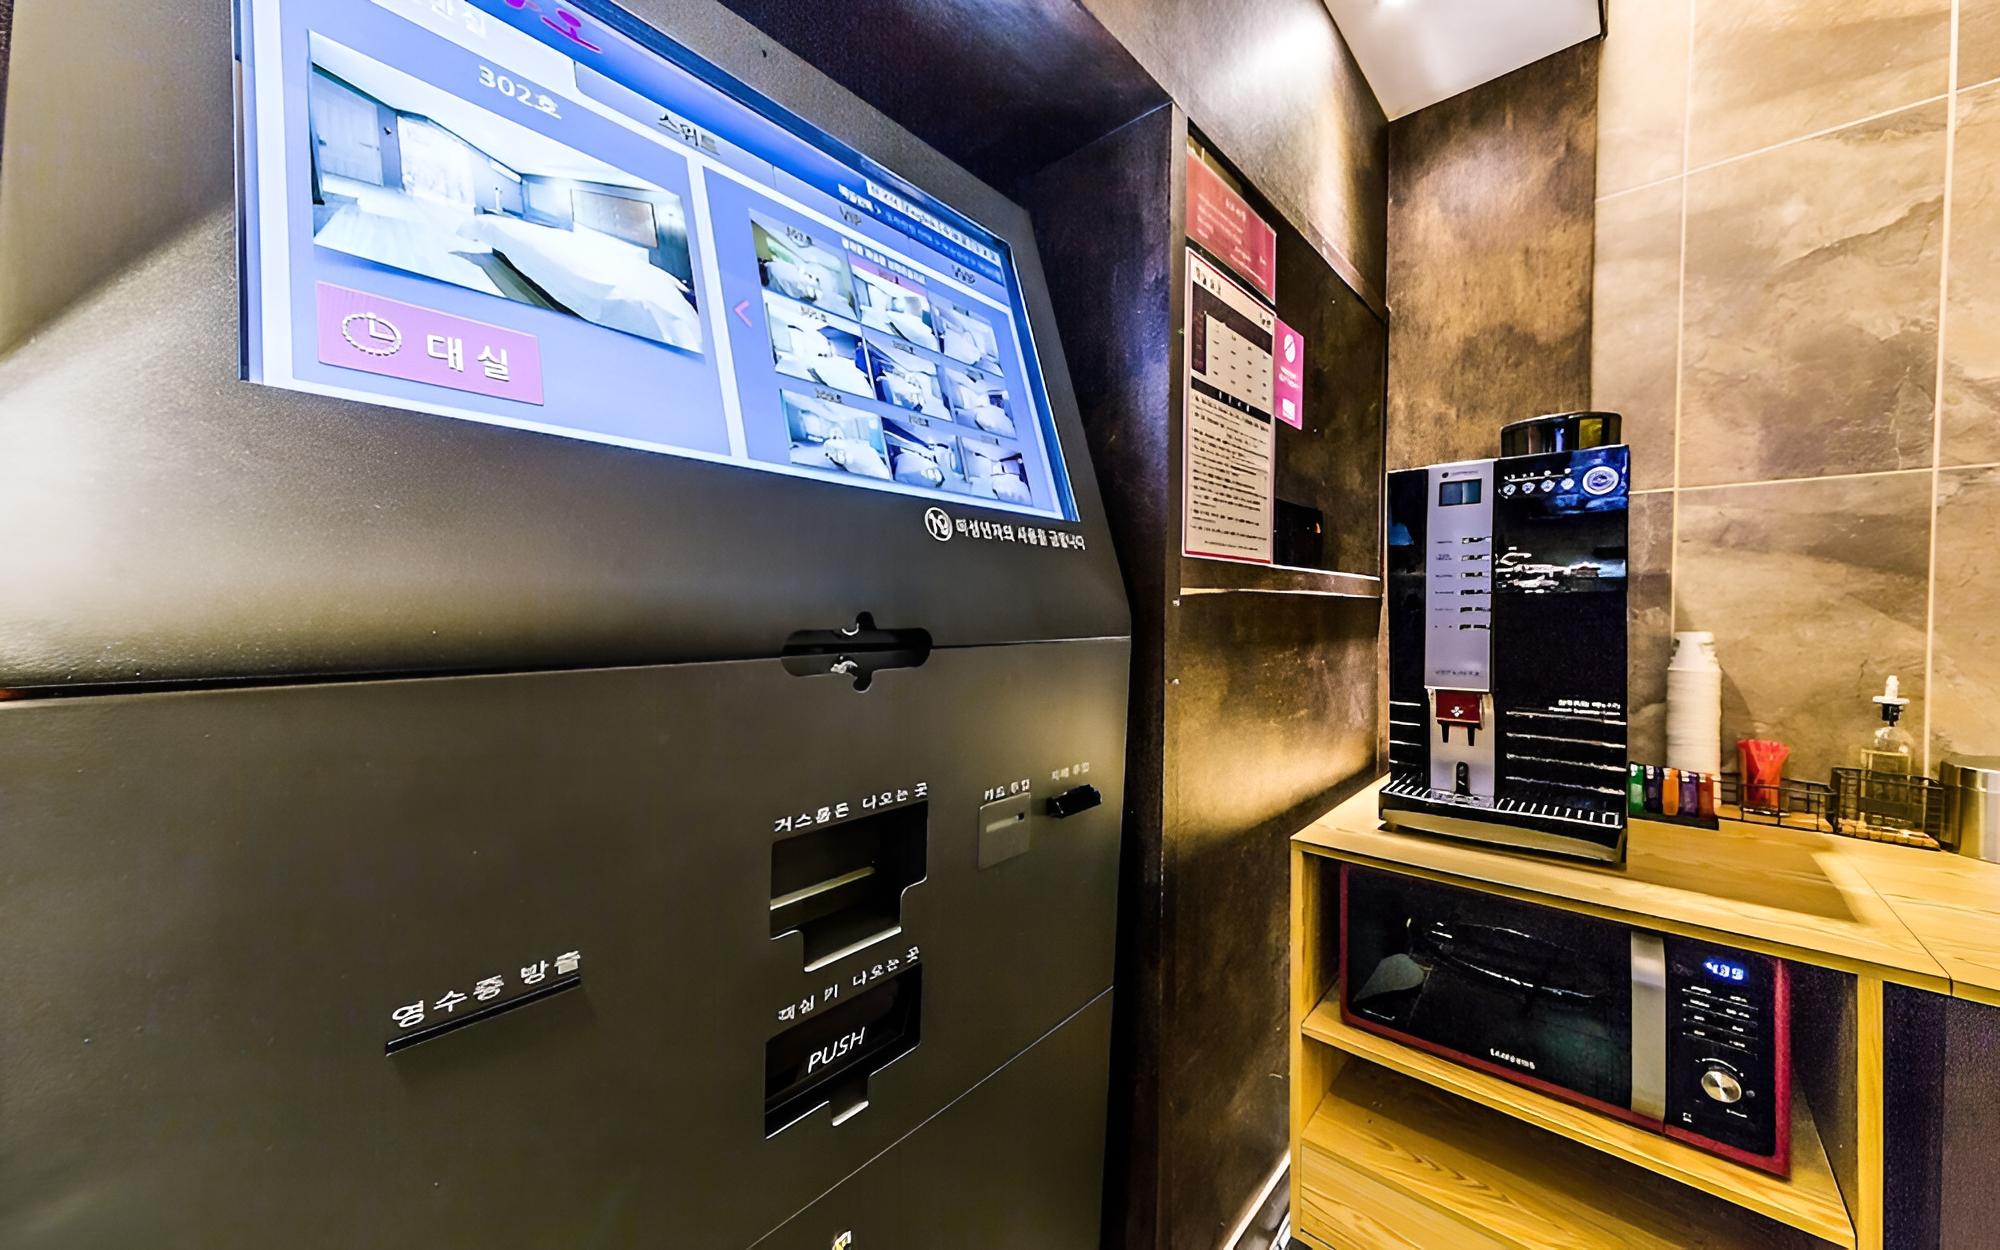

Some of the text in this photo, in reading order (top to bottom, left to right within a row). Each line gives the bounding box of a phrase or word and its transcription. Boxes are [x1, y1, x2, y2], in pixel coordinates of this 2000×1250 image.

[478, 64, 563, 120] 302호
[426, 333, 510, 382] 대실
[862, 789, 909, 809] 나오는
[852, 958, 900, 986] 나오는
[391, 975, 505, 1028] 영수증
[807, 1026, 866, 1074] PUSH
